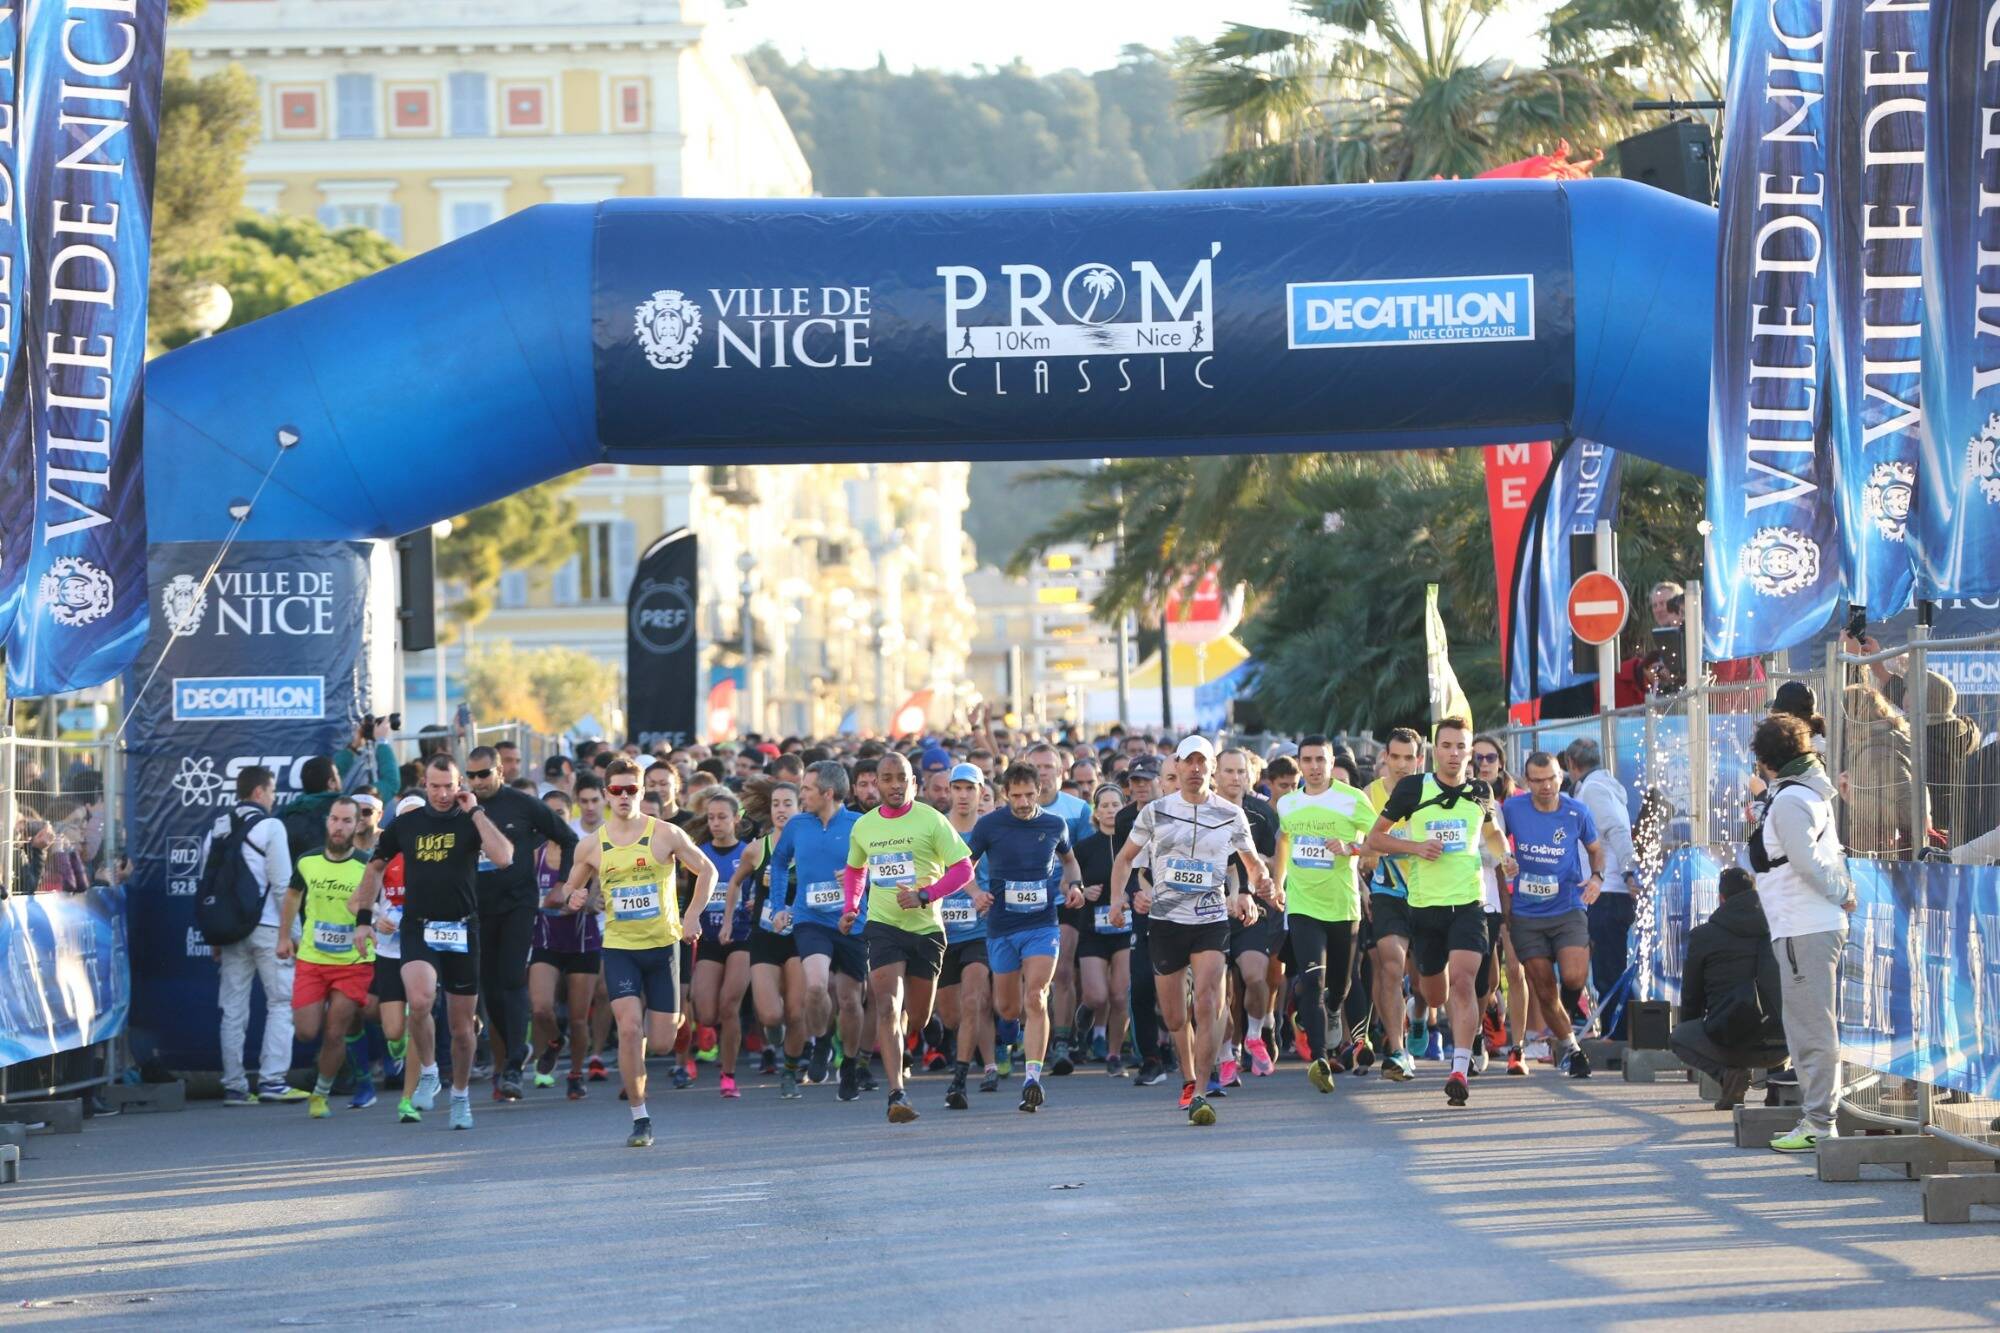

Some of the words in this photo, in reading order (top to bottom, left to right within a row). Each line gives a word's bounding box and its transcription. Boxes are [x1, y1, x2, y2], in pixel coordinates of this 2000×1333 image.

[1754, 172, 1824, 279] DE
[50, 200, 120, 311] DE
[708, 287, 811, 318] VILLE
[820, 286, 872, 316] DE
[1306, 291, 1516, 332] DECATHLON
[994, 331, 1051, 351] 10Km
[1136, 328, 1182, 348] Nice
[1408, 328, 1437, 340] NICE
[1438, 325, 1470, 339] CÔTE
[1471, 326, 1516, 338] D'AZUR
[713, 318, 873, 369] NICE
[947, 355, 1215, 396] CLASSIC
[1744, 303, 1818, 519] VILLE
[44, 331, 113, 547] VILLE
[1575, 443, 1605, 515] NICE
[213, 572, 290, 596] VILLE
[297, 572, 335, 595] DE
[214, 595, 335, 636] NICE
[640, 609, 688, 628] PREF
[182, 686, 314, 710] DECATHLON
[1435, 830, 1461, 842] 9505
[170, 849, 198, 864] RTL2
[1300, 846, 1326, 858] 1021
[879, 864, 905, 877] 9263
[1174, 871, 1203, 884] 8528
[814, 890, 840, 903] 6399
[1017, 892, 1038, 903] 943
[1527, 883, 1551, 895] 1336
[621, 896, 651, 910] 7108
[942, 909, 968, 920] 8978
[321, 932, 347, 944] 1269
